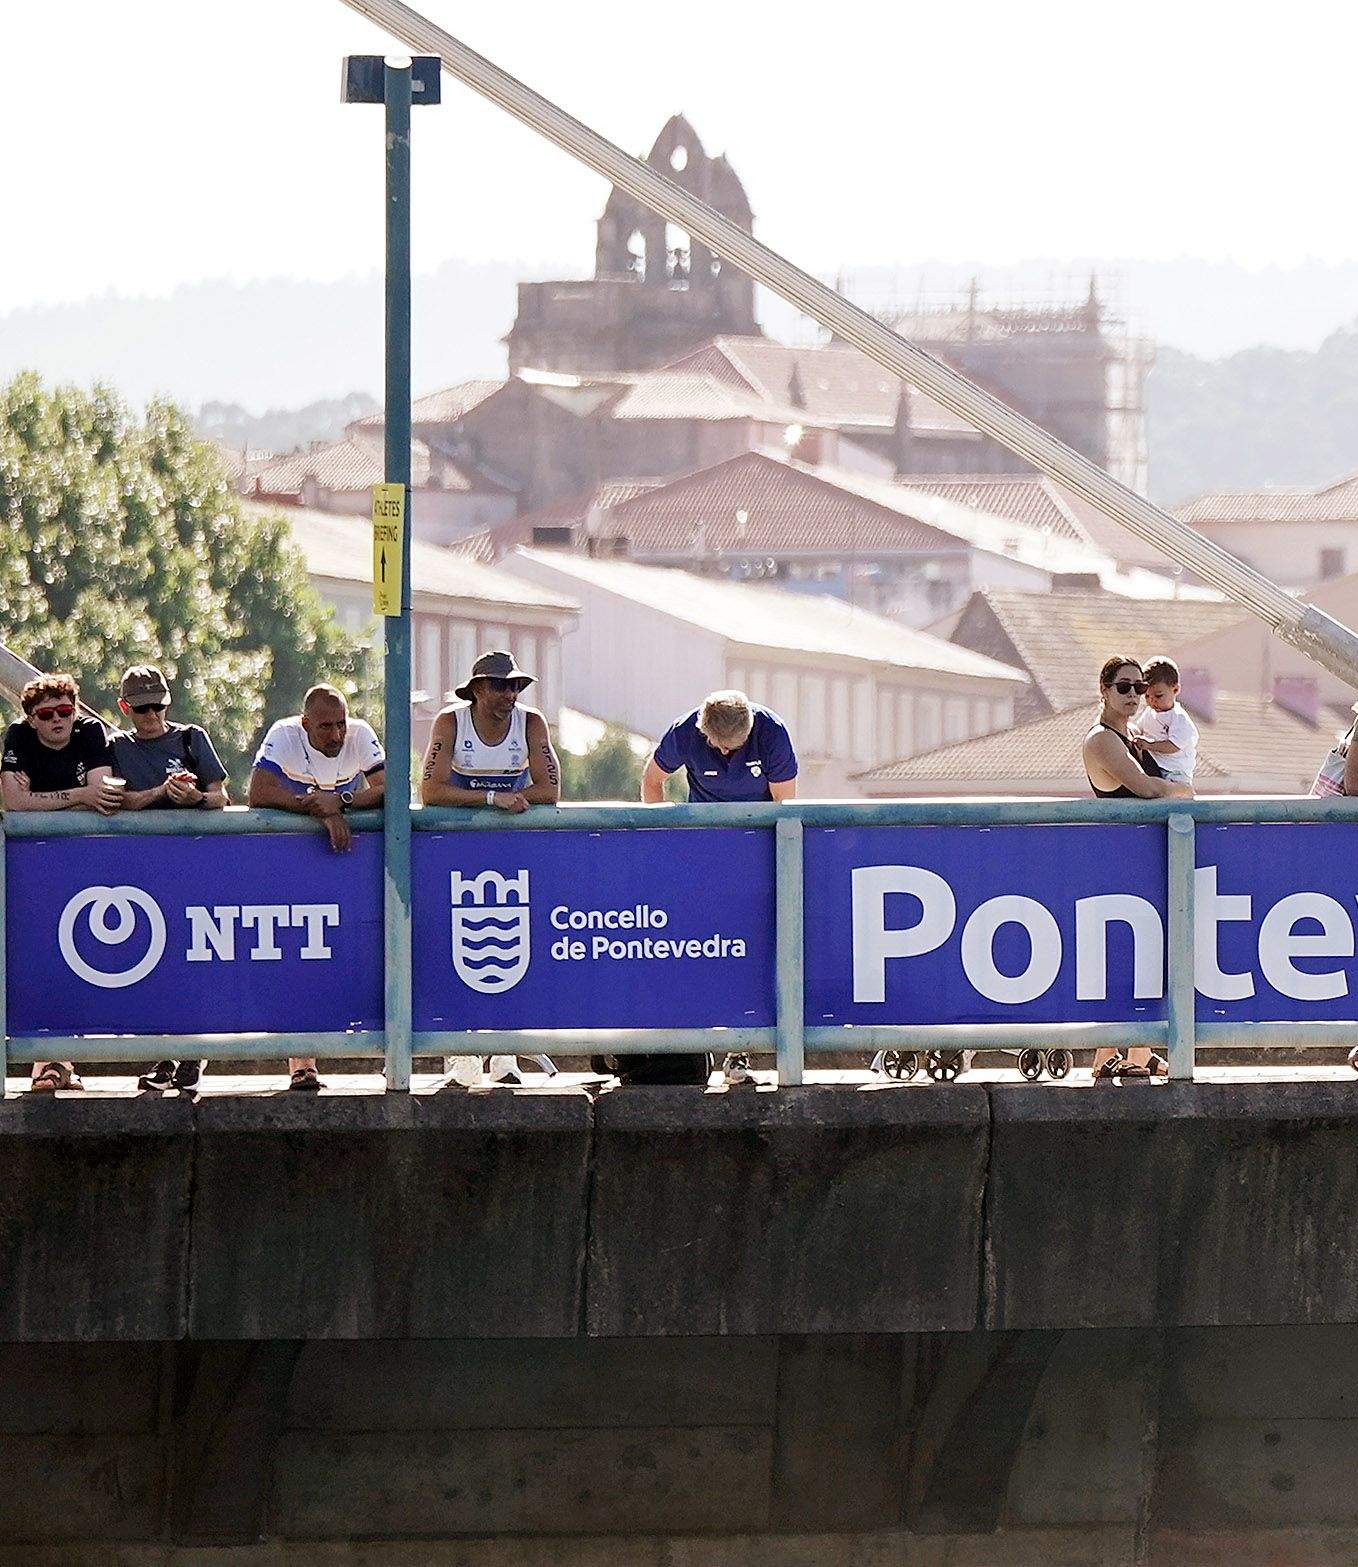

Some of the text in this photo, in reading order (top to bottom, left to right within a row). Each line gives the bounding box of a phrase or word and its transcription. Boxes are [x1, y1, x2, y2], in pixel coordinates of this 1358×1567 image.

[423, 742, 442, 781] 3125
[185, 903, 340, 962] NTT
[550, 904, 668, 930] Concello
[550, 933, 746, 961] de Pontevedra
